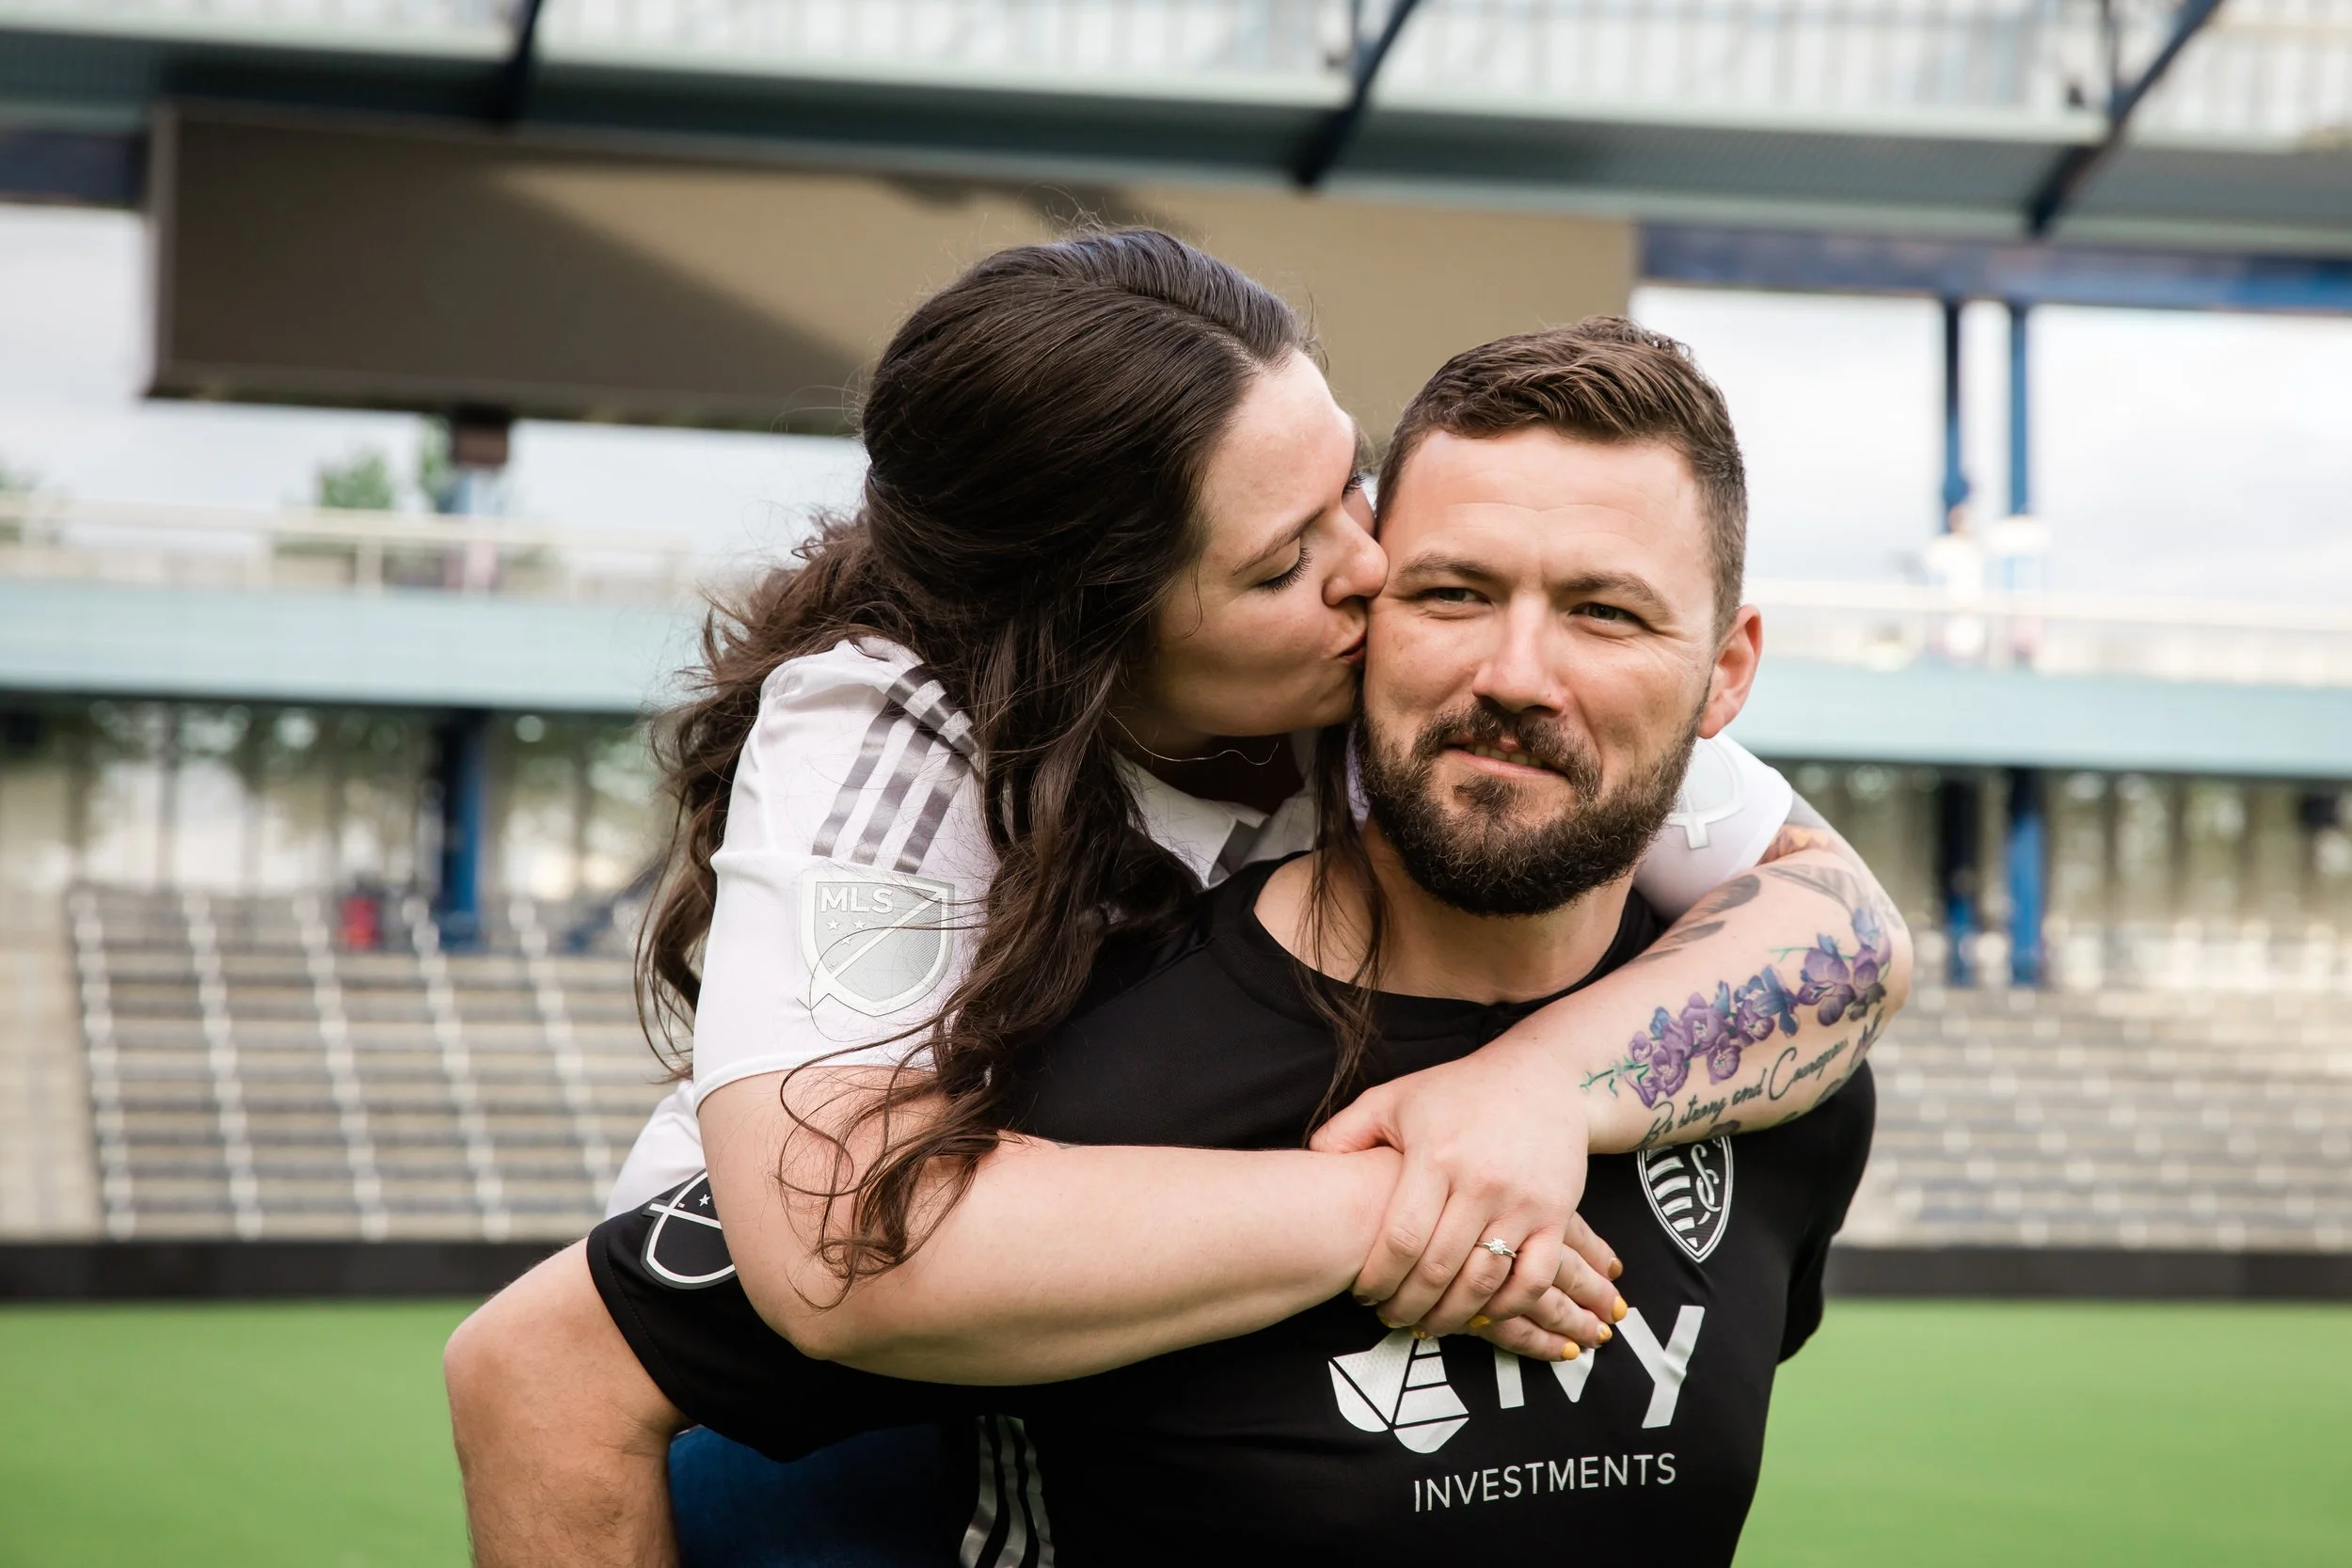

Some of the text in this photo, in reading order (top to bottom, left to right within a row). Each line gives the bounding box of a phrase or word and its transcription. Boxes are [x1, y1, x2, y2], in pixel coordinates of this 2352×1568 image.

[820, 887, 894, 913] MLS
[1732, 1069, 1767, 1106] and
[1414, 1452, 1677, 1513] INVESTMENTS
